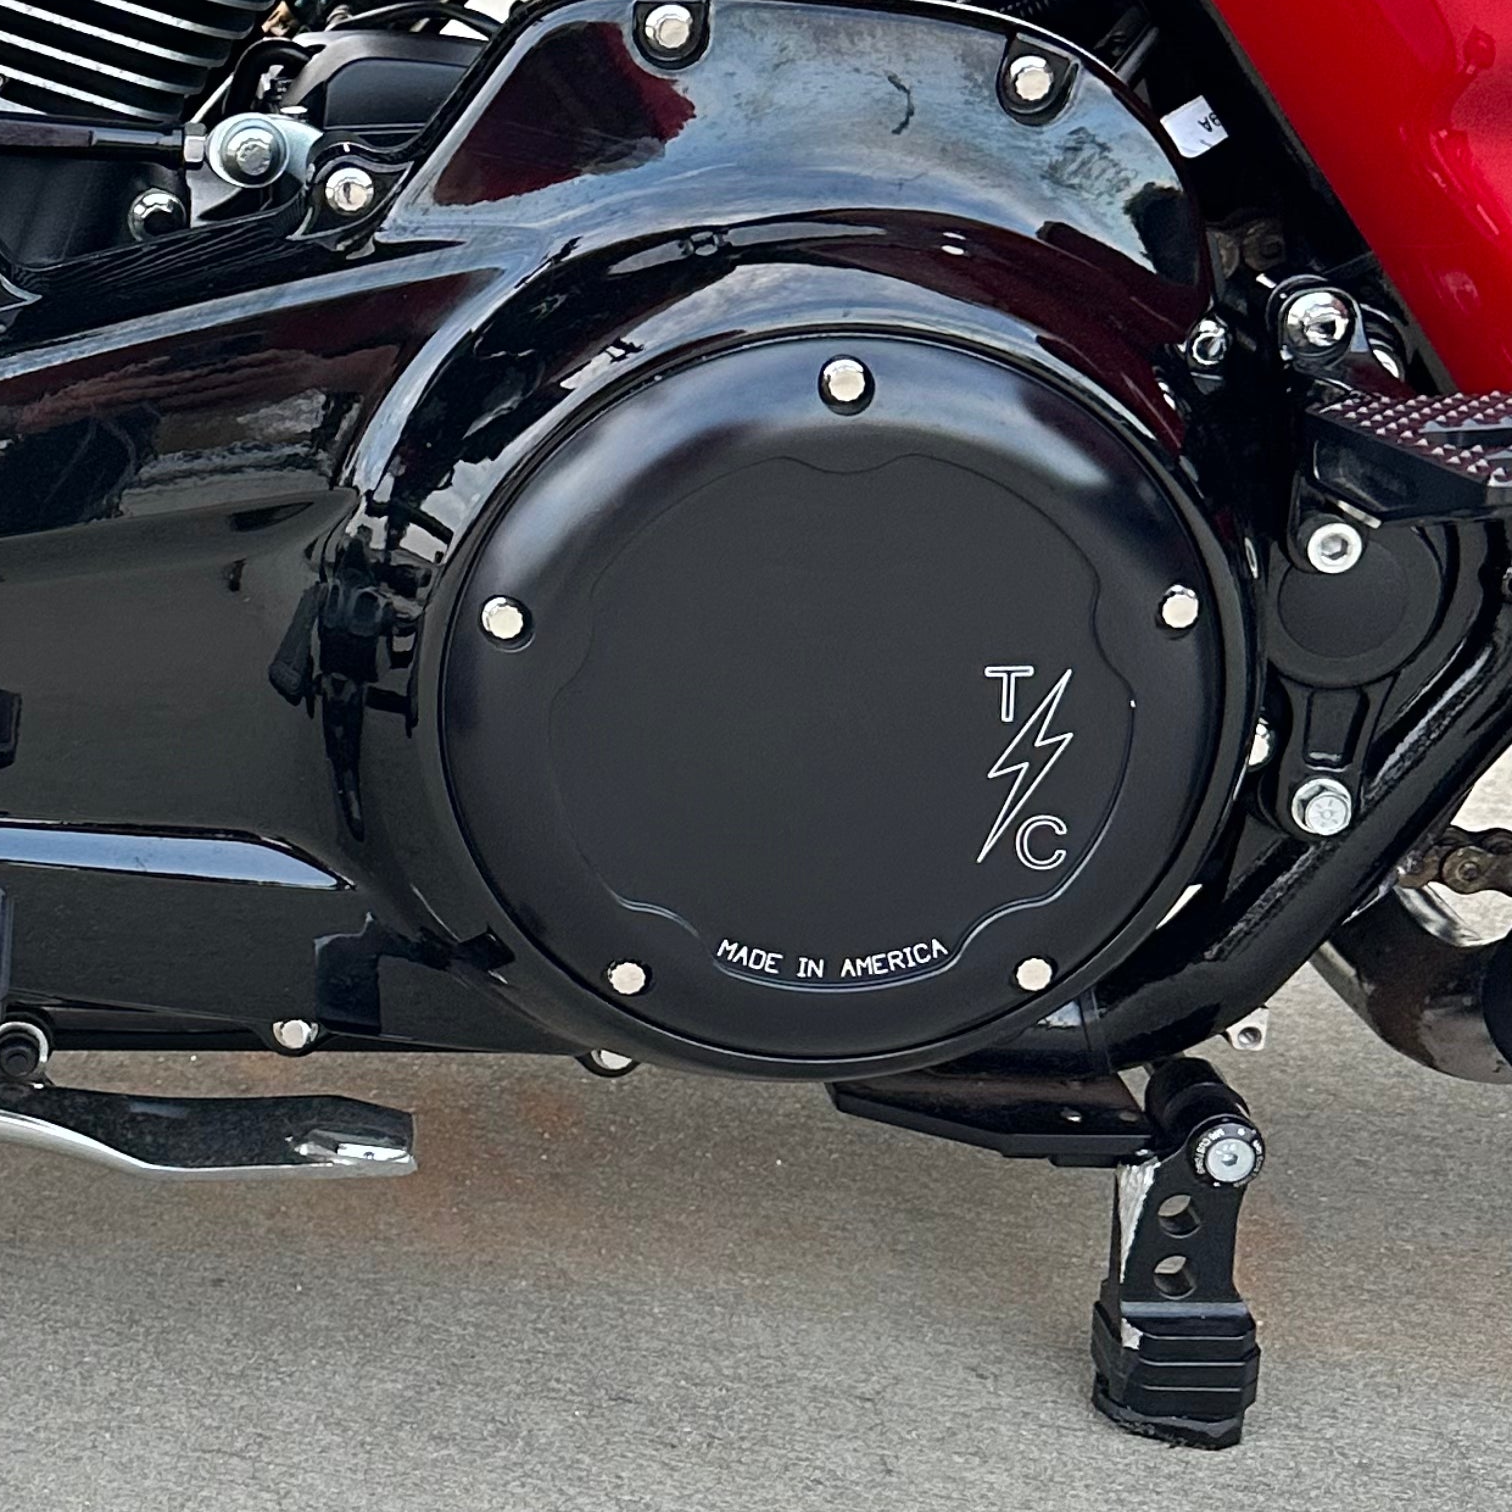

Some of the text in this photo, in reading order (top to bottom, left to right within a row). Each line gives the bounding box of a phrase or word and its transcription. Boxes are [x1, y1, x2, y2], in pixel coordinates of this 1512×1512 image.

[984, 665, 1034, 723] T
[1014, 815, 1067, 870] C
[717, 938, 949, 978] MADE IN AMERICA
